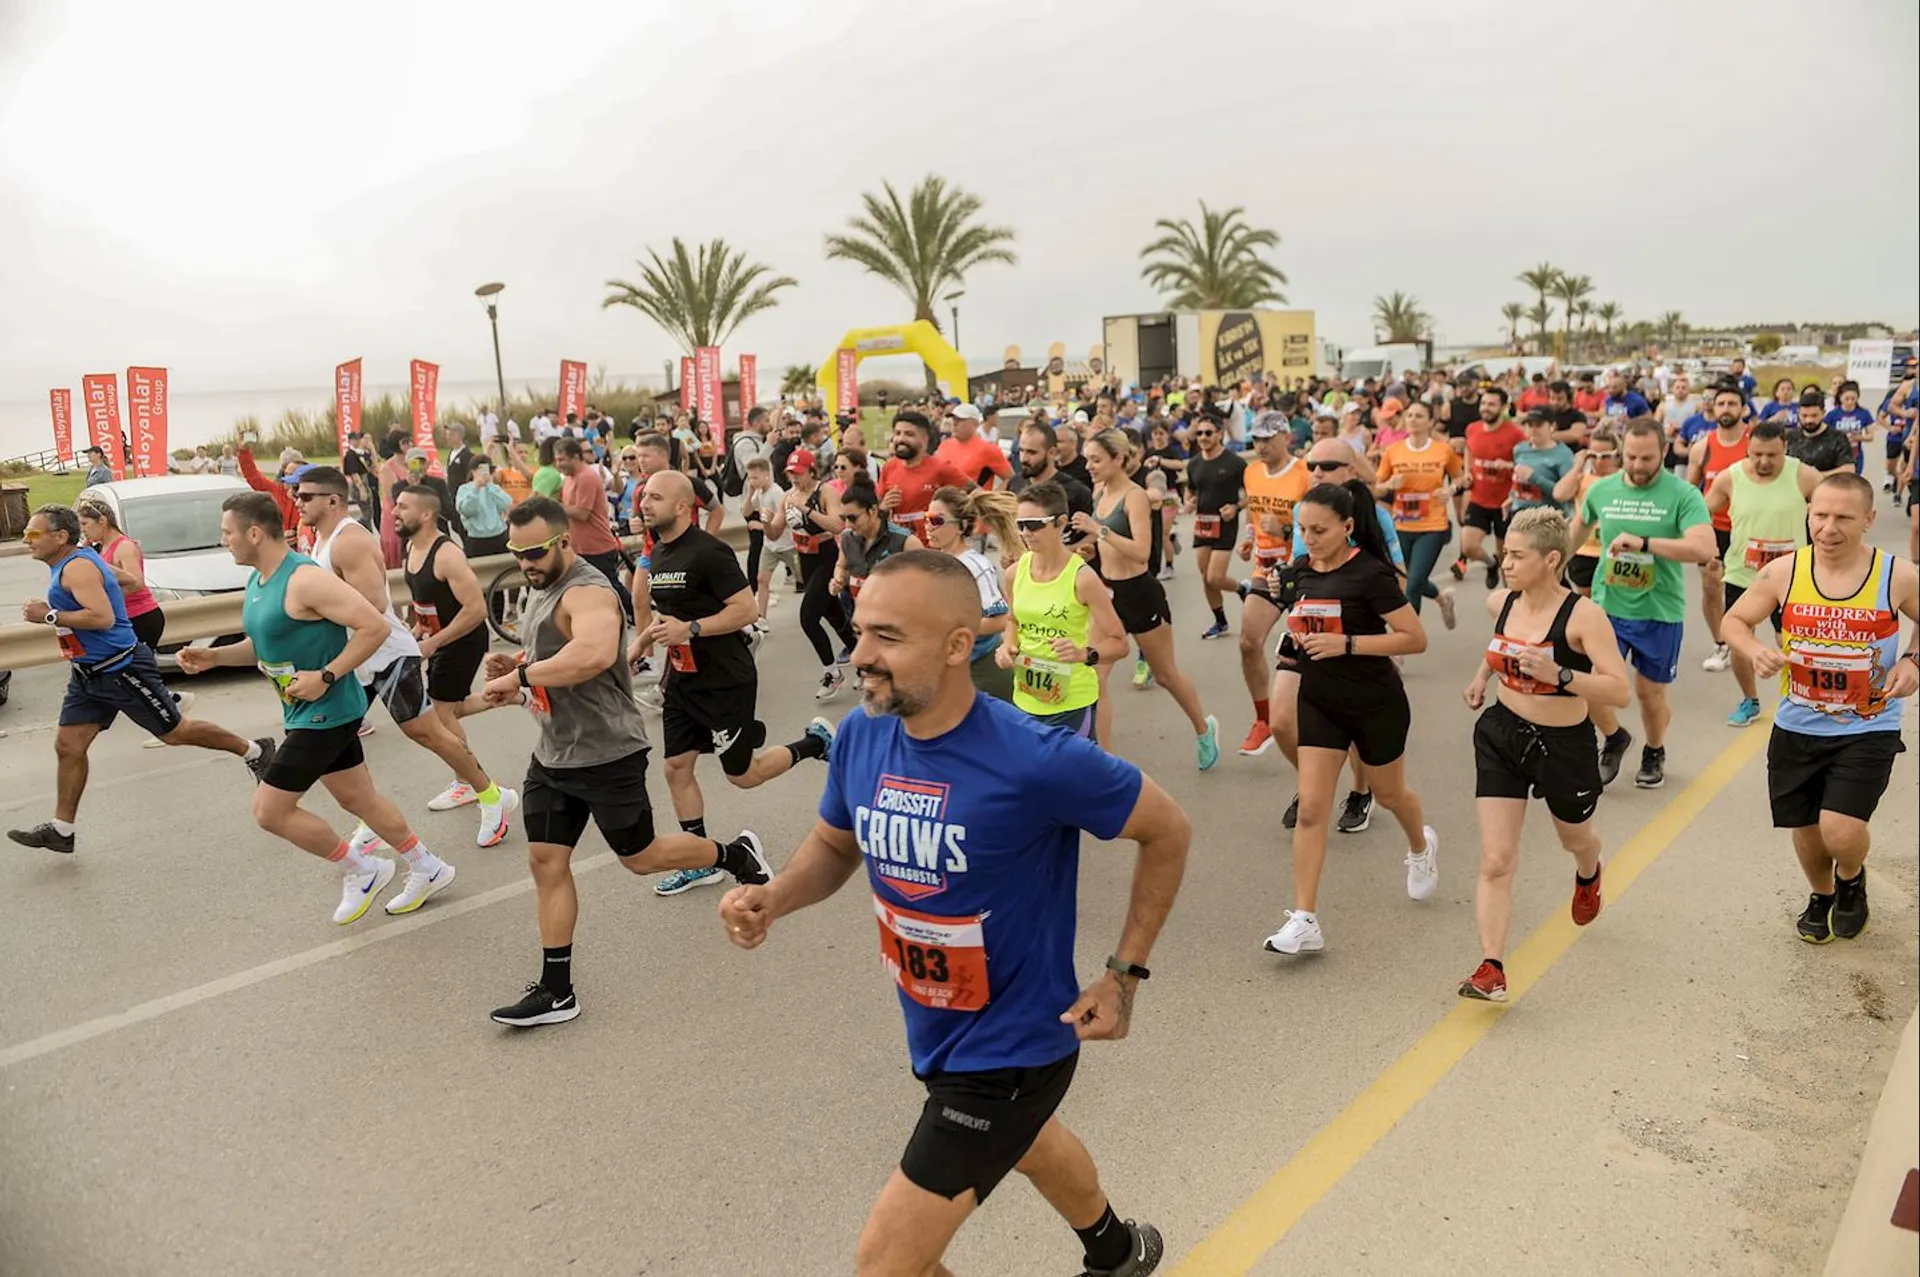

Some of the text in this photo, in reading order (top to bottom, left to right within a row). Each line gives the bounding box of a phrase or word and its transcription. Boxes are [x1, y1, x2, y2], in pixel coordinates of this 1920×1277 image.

[107, 384, 116, 416] Group
[152, 379, 164, 415] Group
[700, 350, 714, 421] Noyanlar
[53, 390, 67, 439] Noyanlar
[133, 373, 156, 468] Noyanlar
[1613, 561, 1640, 578] 024
[1792, 604, 1877, 621] CHILDREN
[1816, 618, 1847, 630] with
[1790, 624, 1877, 640] LEUKAEMIA
[1026, 669, 1053, 692] 014
[1791, 681, 1811, 698] 10K
[1809, 669, 1848, 690] 139
[878, 788, 943, 818] CROSSFIT
[855, 806, 968, 873] CROWS
[896, 938, 949, 983] 183
